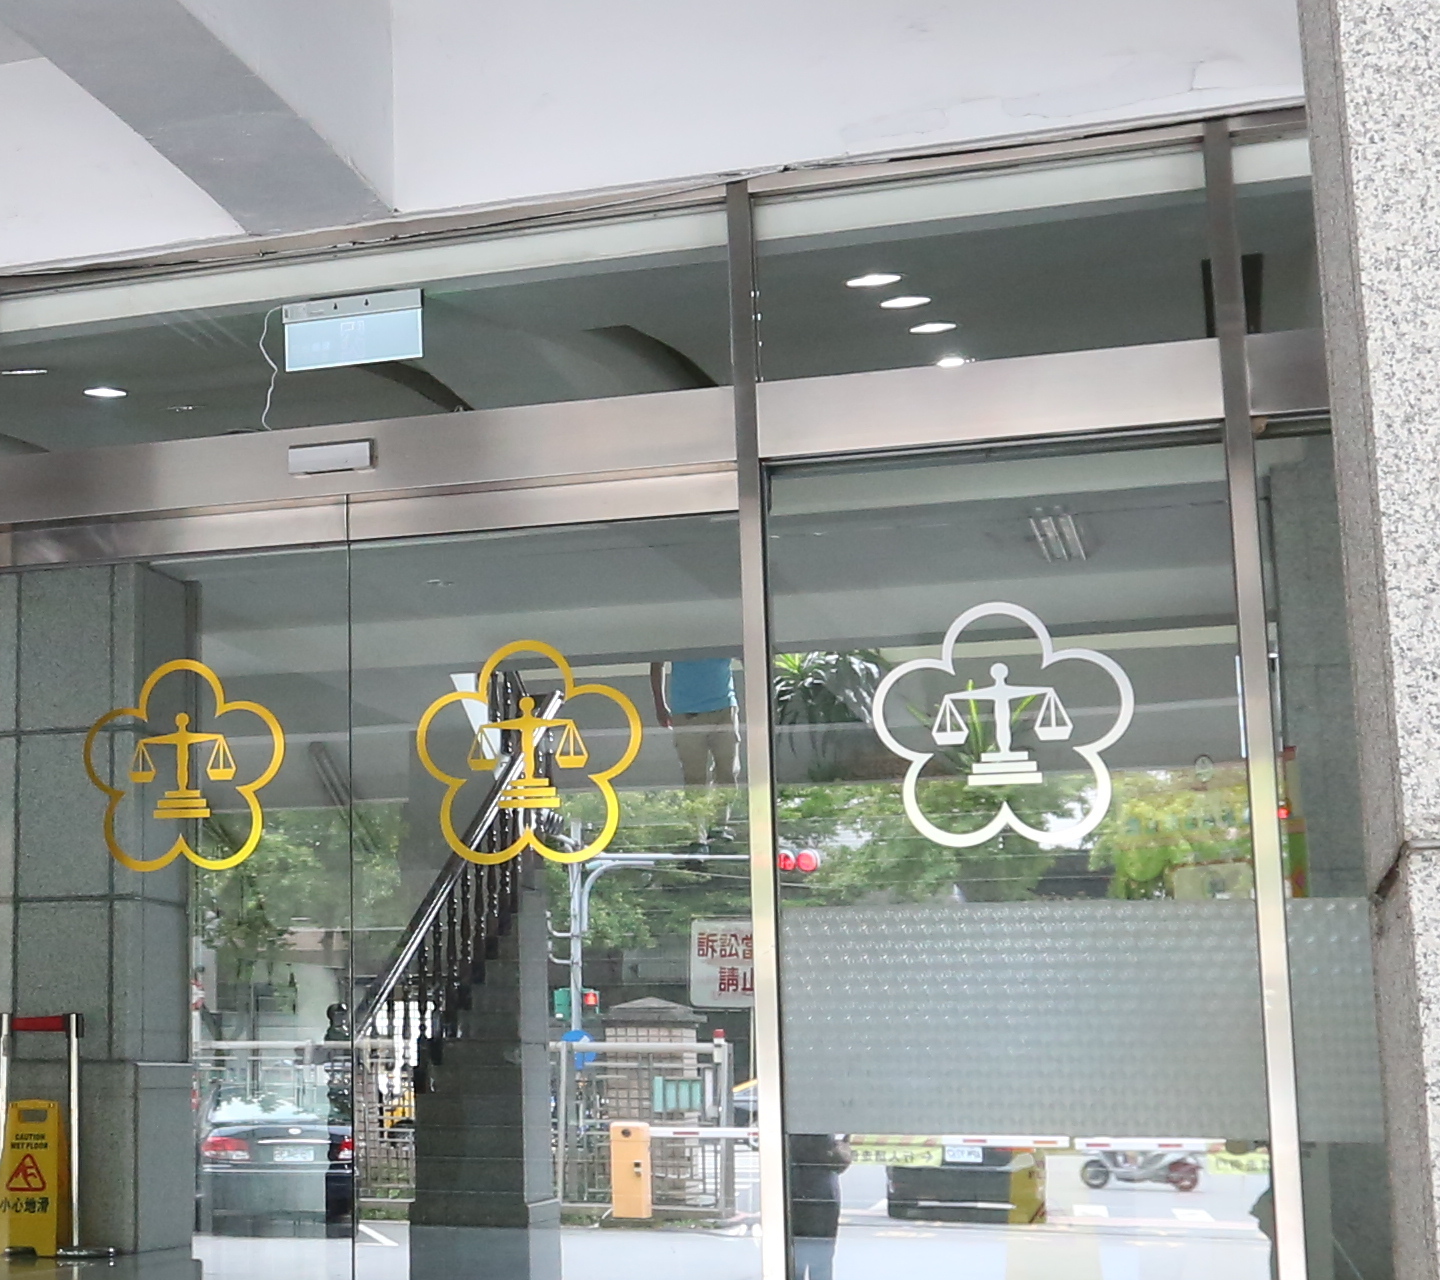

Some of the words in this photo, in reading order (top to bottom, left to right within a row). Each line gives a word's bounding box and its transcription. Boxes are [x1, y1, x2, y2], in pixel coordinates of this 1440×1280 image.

[15, 1133, 45, 1141] CAUTION
[11, 1142, 25, 1150] WET
[26, 1142, 48, 1151] FLOOR
[0, 1197, 49, 1213] 小心地滑
